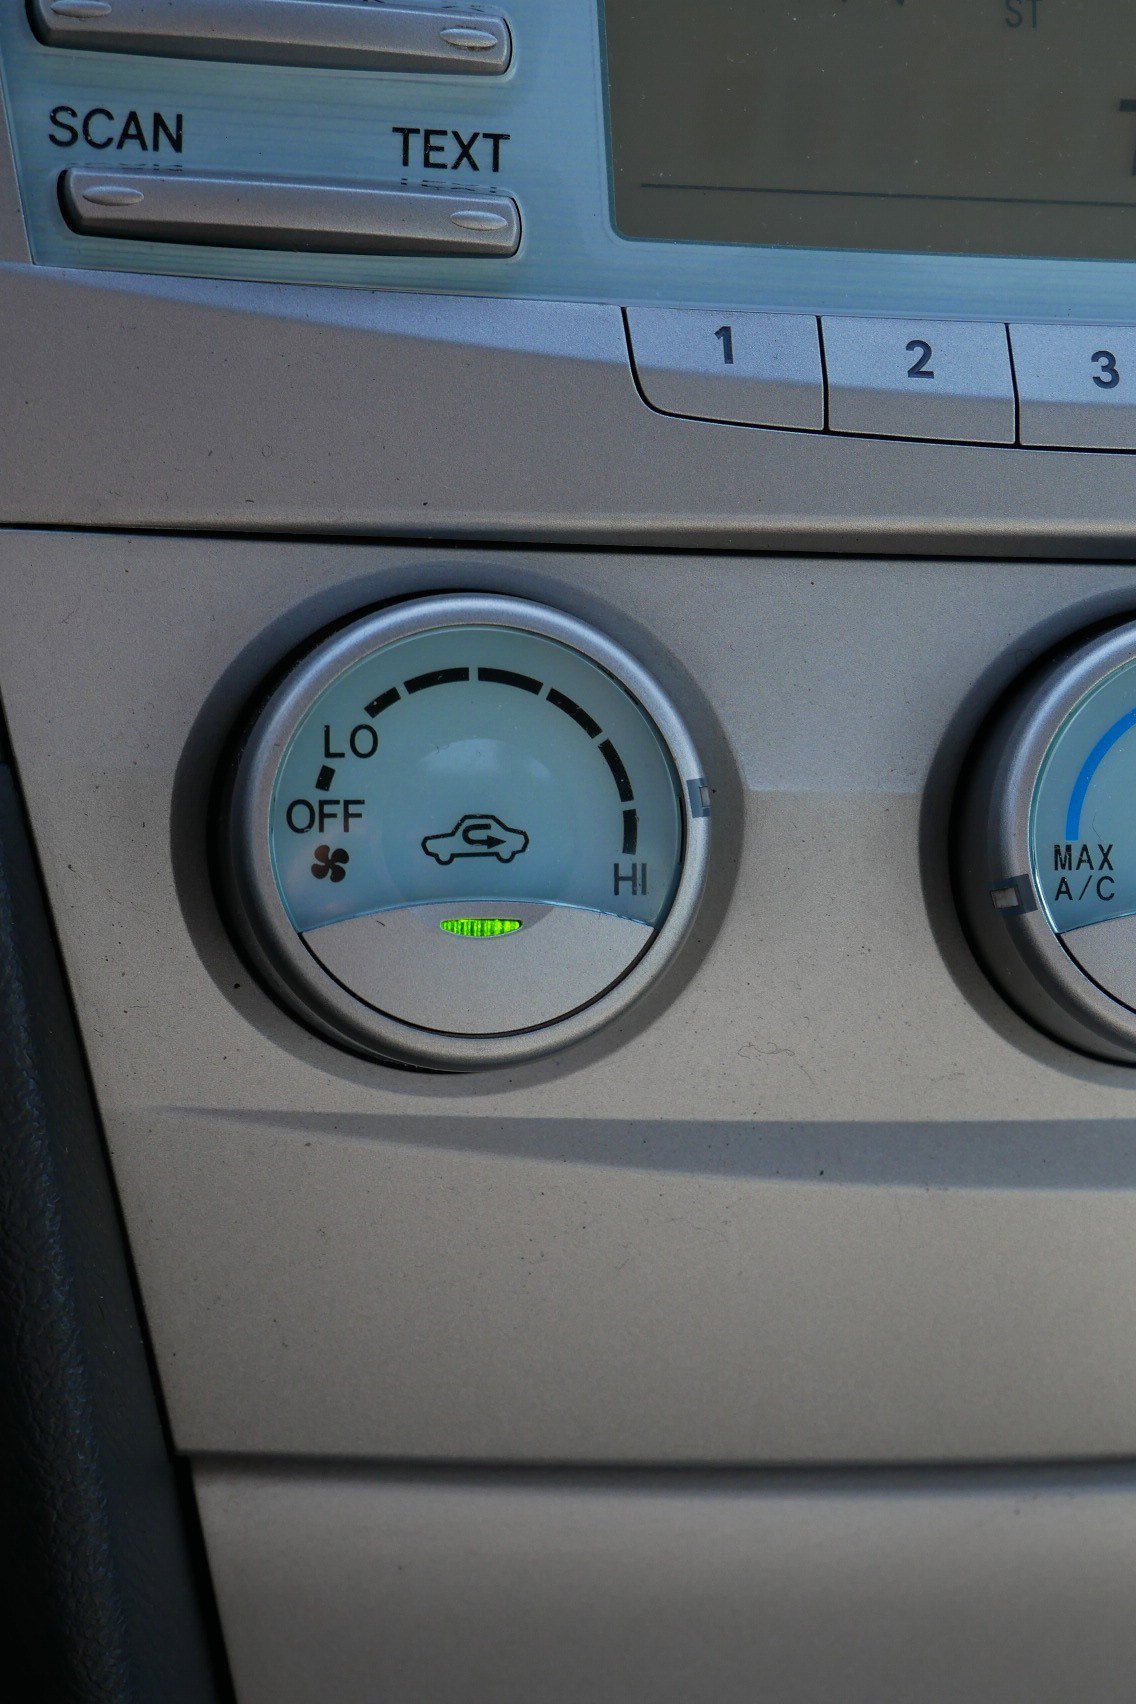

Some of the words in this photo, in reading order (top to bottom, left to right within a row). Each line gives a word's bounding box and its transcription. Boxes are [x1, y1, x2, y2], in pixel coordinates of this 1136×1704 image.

[48, 106, 184, 154] SCAN
[392, 127, 511, 173] TEXT
[714, 325, 735, 365] 1
[905, 339, 935, 379] 2
[1090, 350, 1121, 389] 3
[323, 723, 380, 759] LO
[285, 799, 366, 834] OFF
[1053, 843, 1115, 872] MAX
[613, 862, 648, 896] HI
[1054, 875, 1116, 901] A/C
